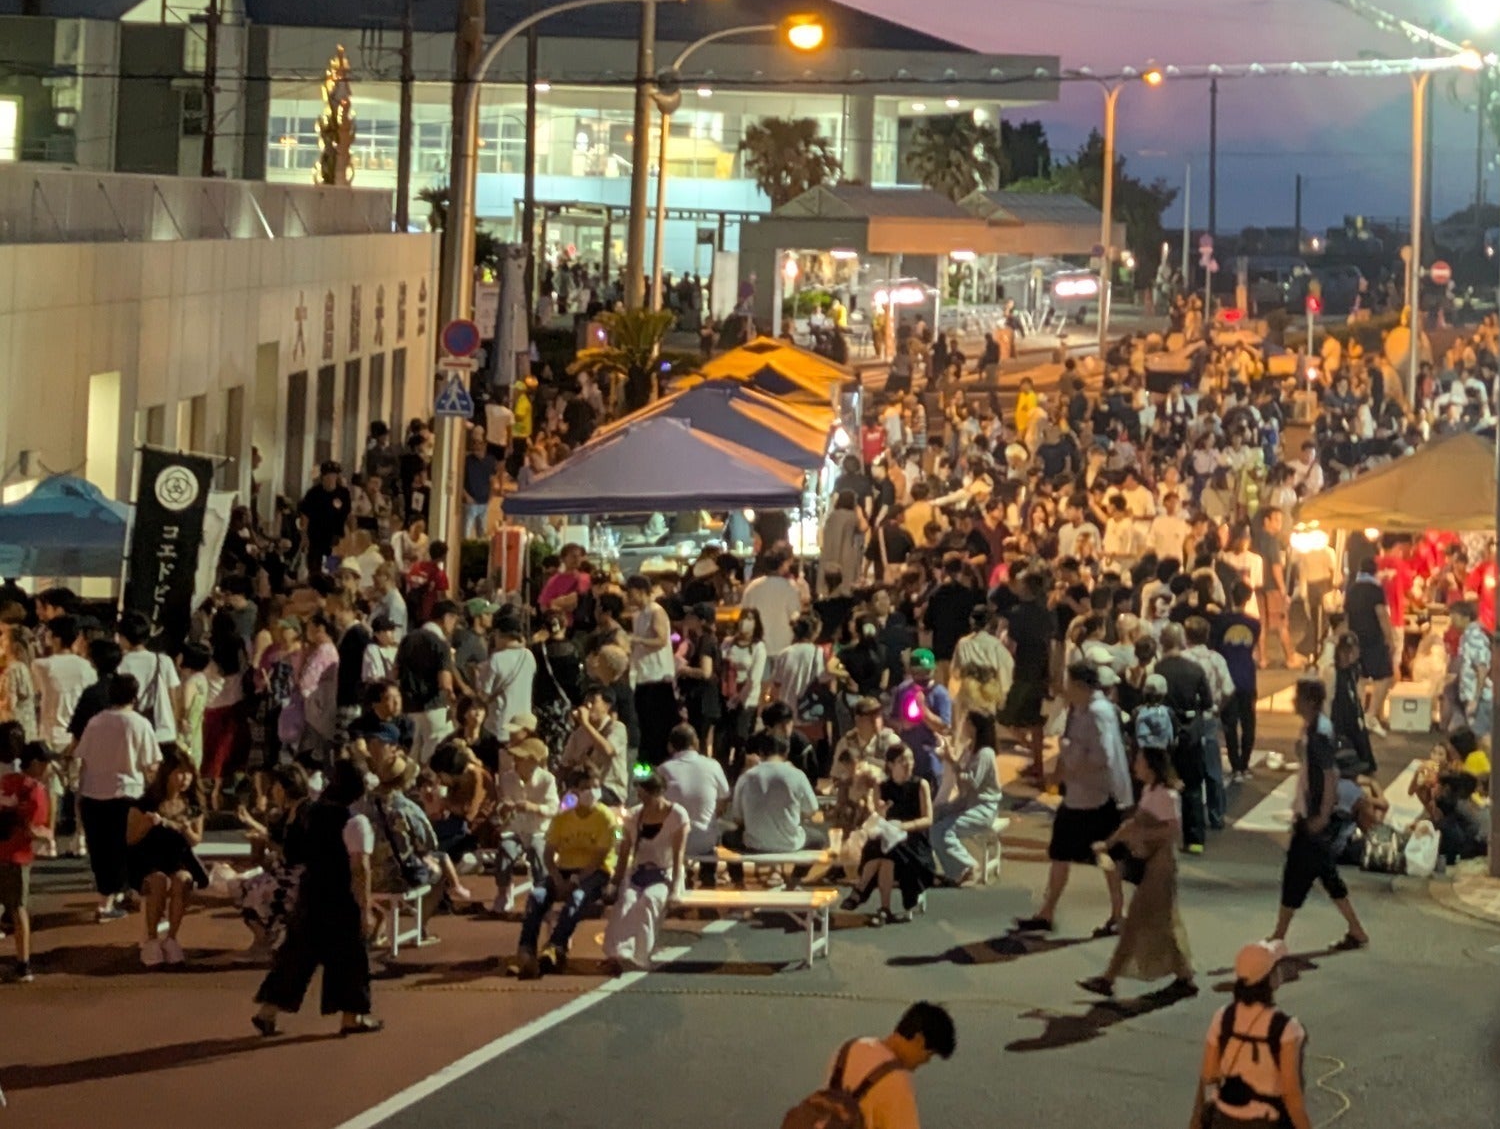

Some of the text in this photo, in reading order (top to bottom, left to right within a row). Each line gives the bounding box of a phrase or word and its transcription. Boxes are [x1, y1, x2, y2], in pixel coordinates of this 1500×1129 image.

[151, 525, 180, 638] コエドビール
